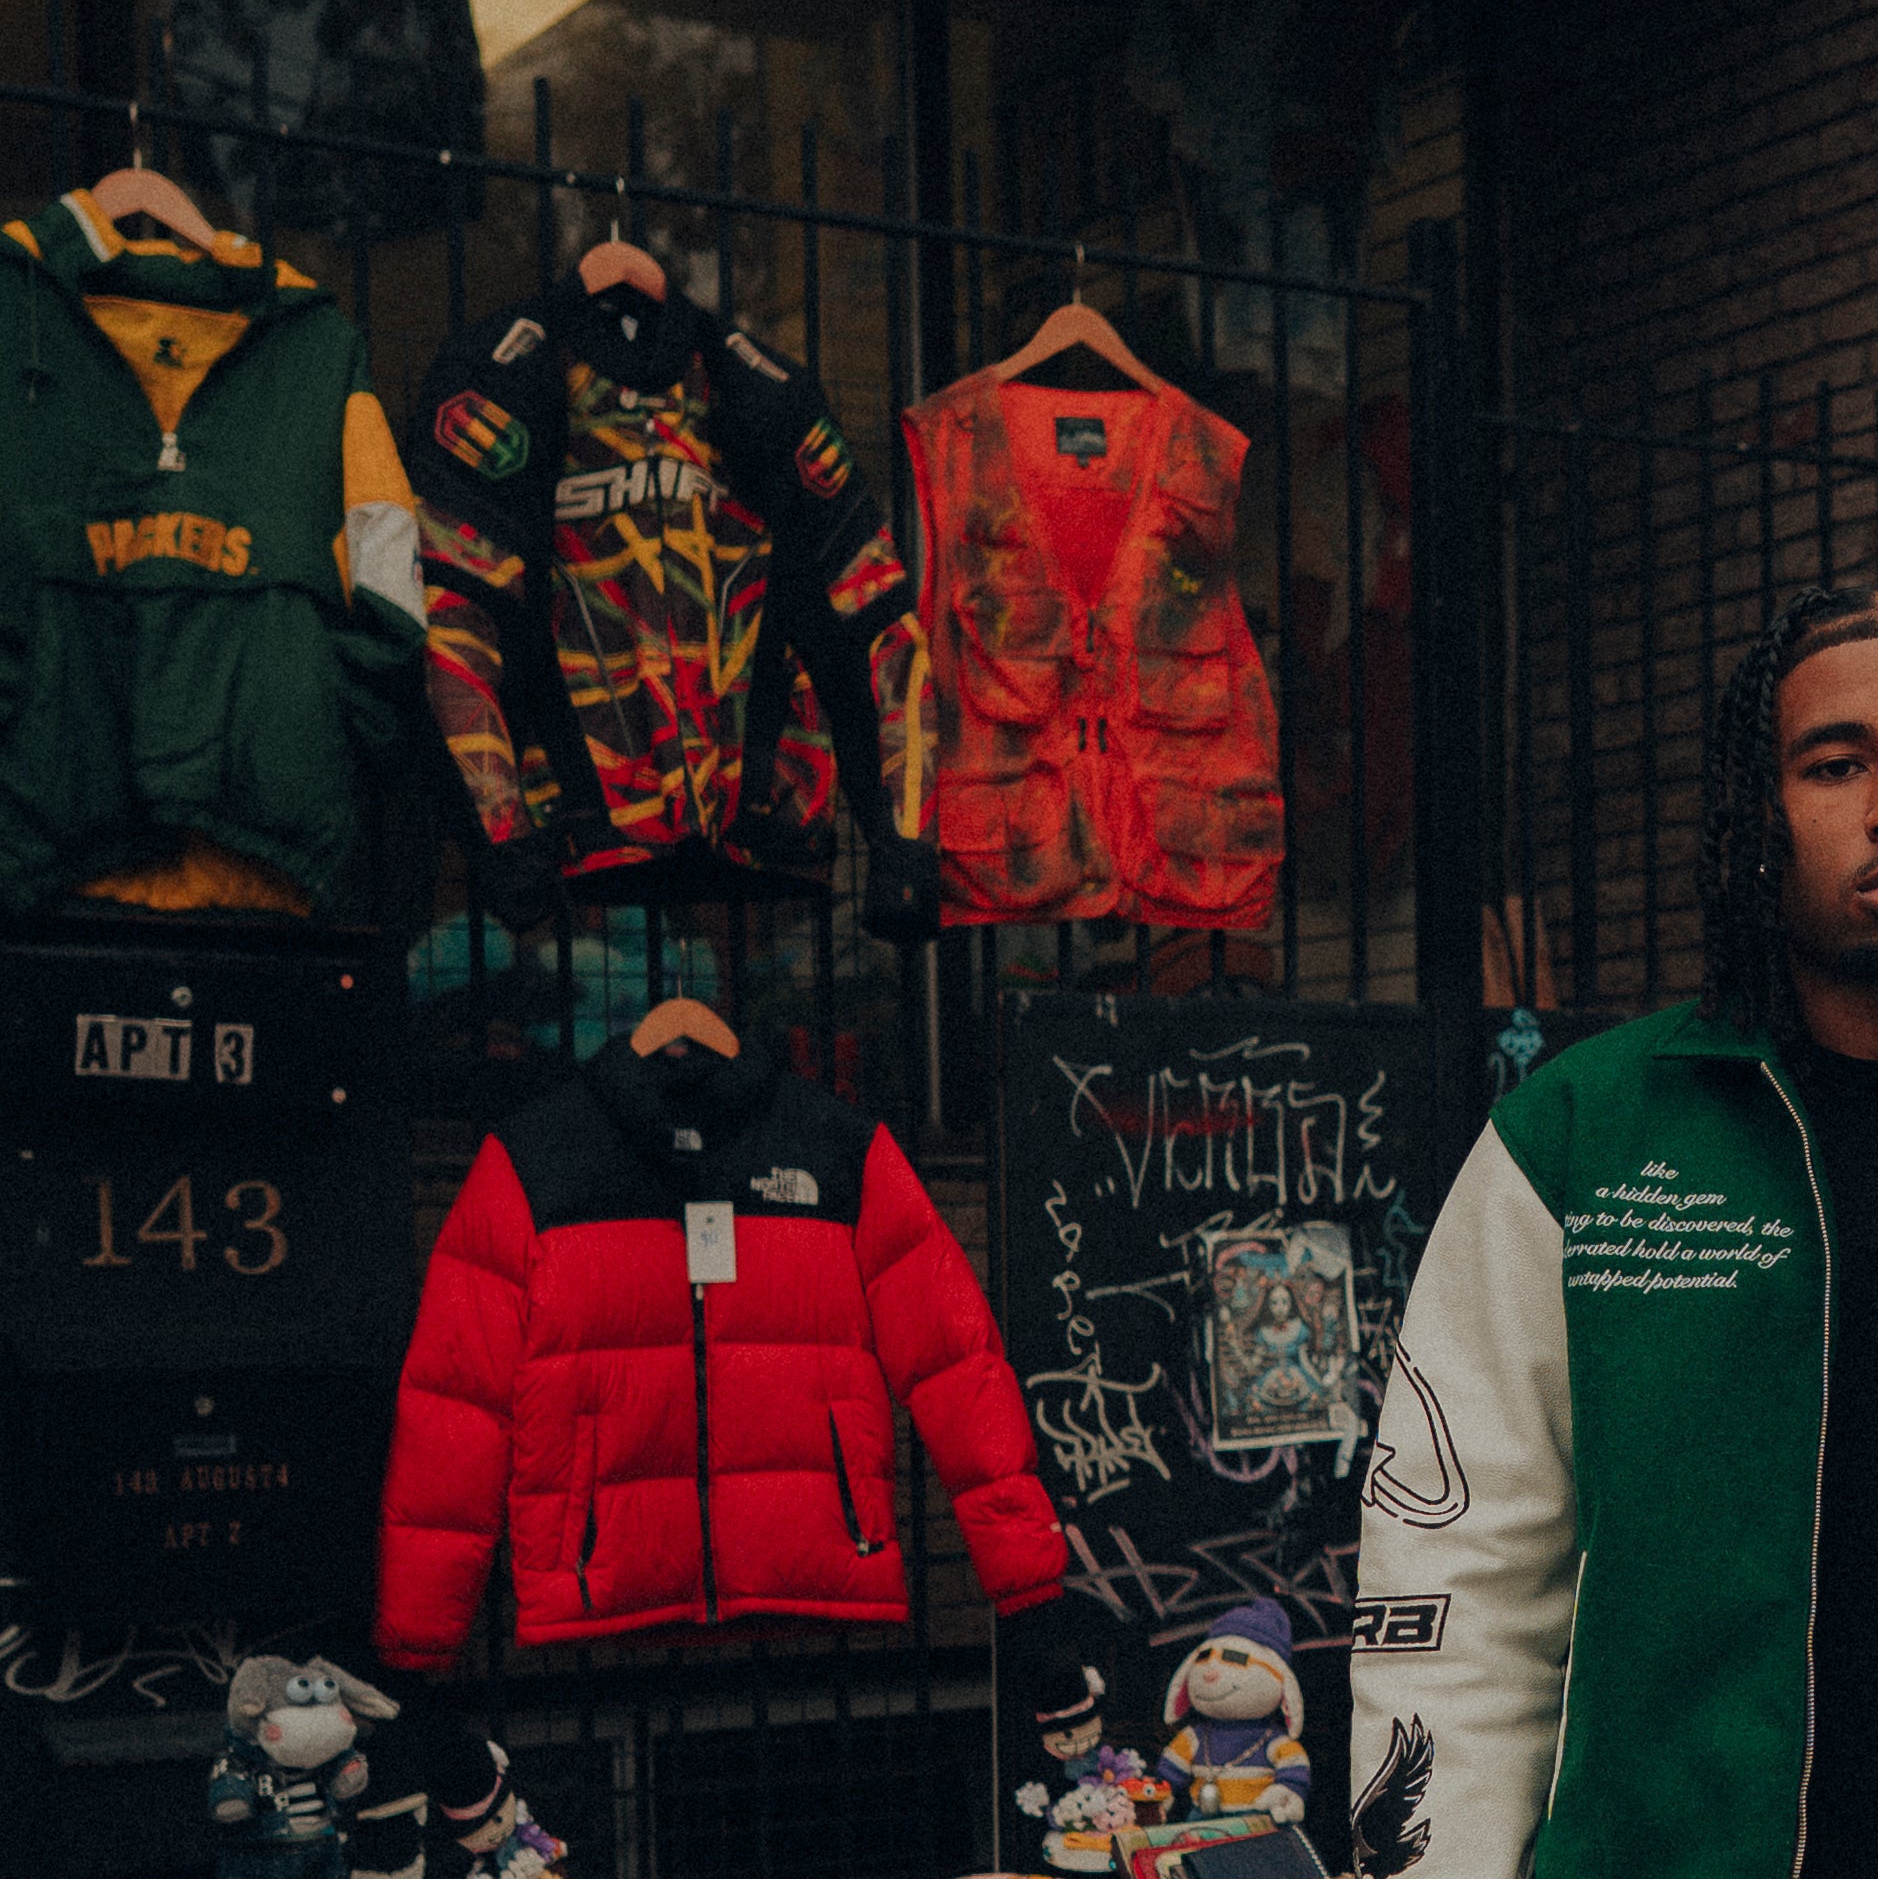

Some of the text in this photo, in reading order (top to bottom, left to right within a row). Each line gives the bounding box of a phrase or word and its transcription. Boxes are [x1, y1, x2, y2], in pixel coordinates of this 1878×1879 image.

[553, 456, 729, 522] SHIFT
[85, 511, 259, 578] PACKERS
[80, 1023, 246, 1080] APT 3
[1640, 1160, 1679, 1180] like
[1610, 1183, 1679, 1205] hidden
[1674, 1192, 1727, 1211] gem
[80, 1174, 289, 1275] 143
[1595, 1211, 1617, 1227] to
[1620, 1209, 1645, 1228] be
[1647, 1212, 1754, 1237] discovered,
[1760, 1218, 1795, 1238] the
[1631, 1239, 1681, 1261] hold
[1698, 1242, 1759, 1266] world
[1757, 1247, 1792, 1270] of
[1567, 1268, 1739, 1295] untapped potential.
